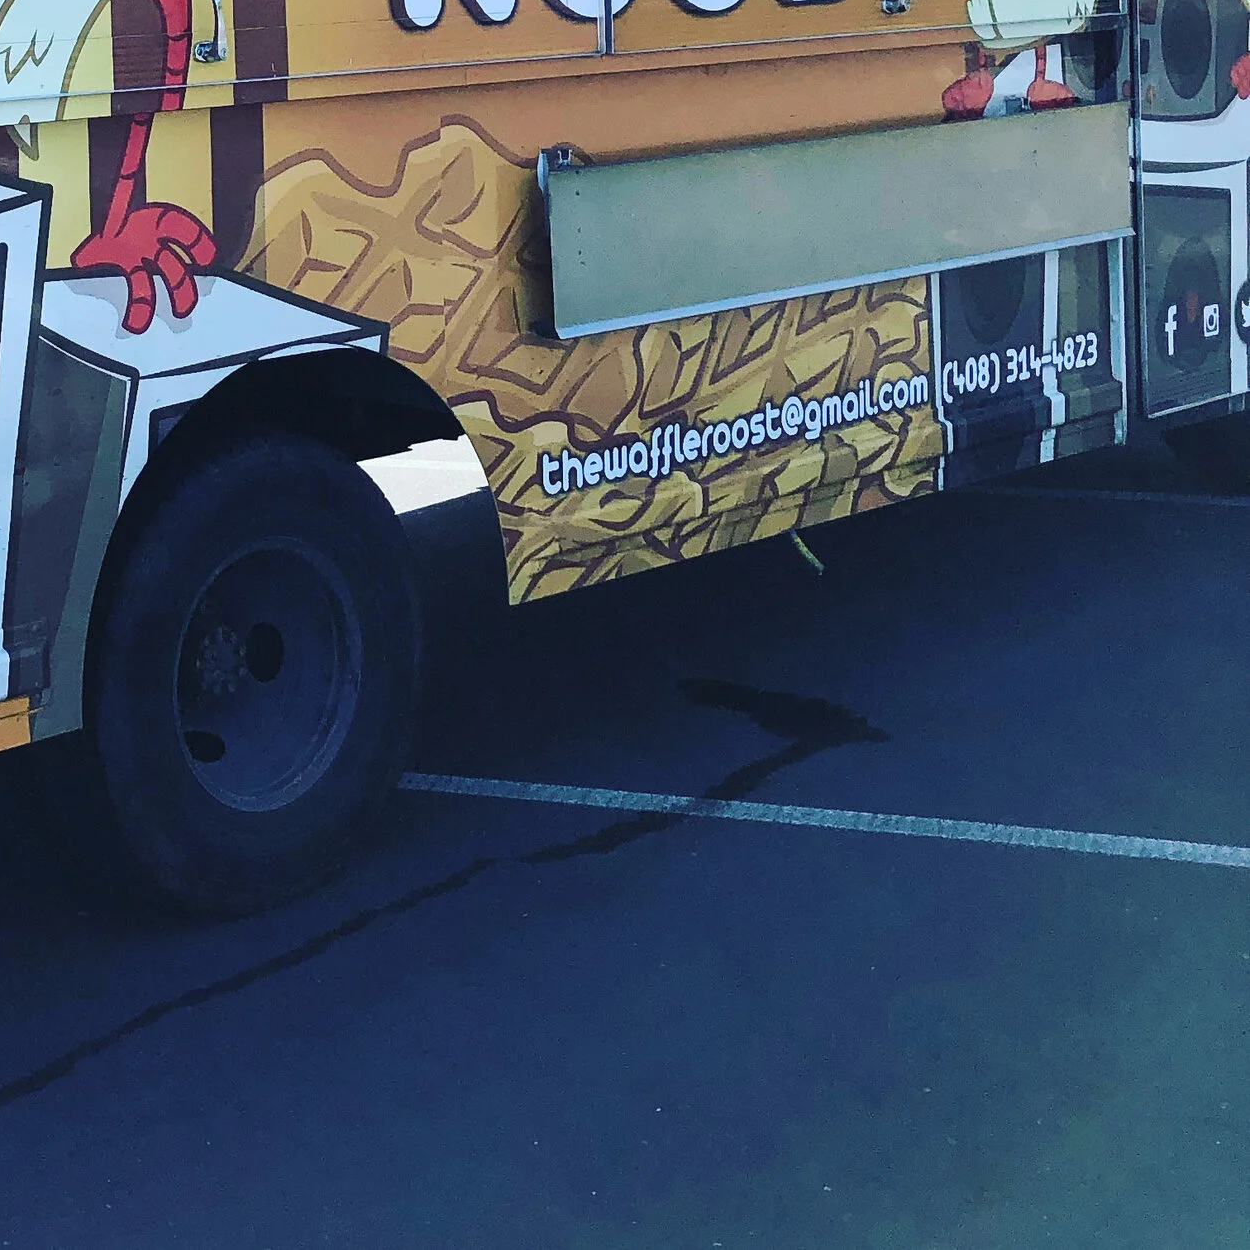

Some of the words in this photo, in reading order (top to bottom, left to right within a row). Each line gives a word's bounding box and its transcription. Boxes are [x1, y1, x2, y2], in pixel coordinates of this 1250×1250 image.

[942, 352, 1000, 403] (408)
[1006, 332, 1098, 383] 314-4823
[542, 374, 928, 495] thewaffleroost@gmail.com
